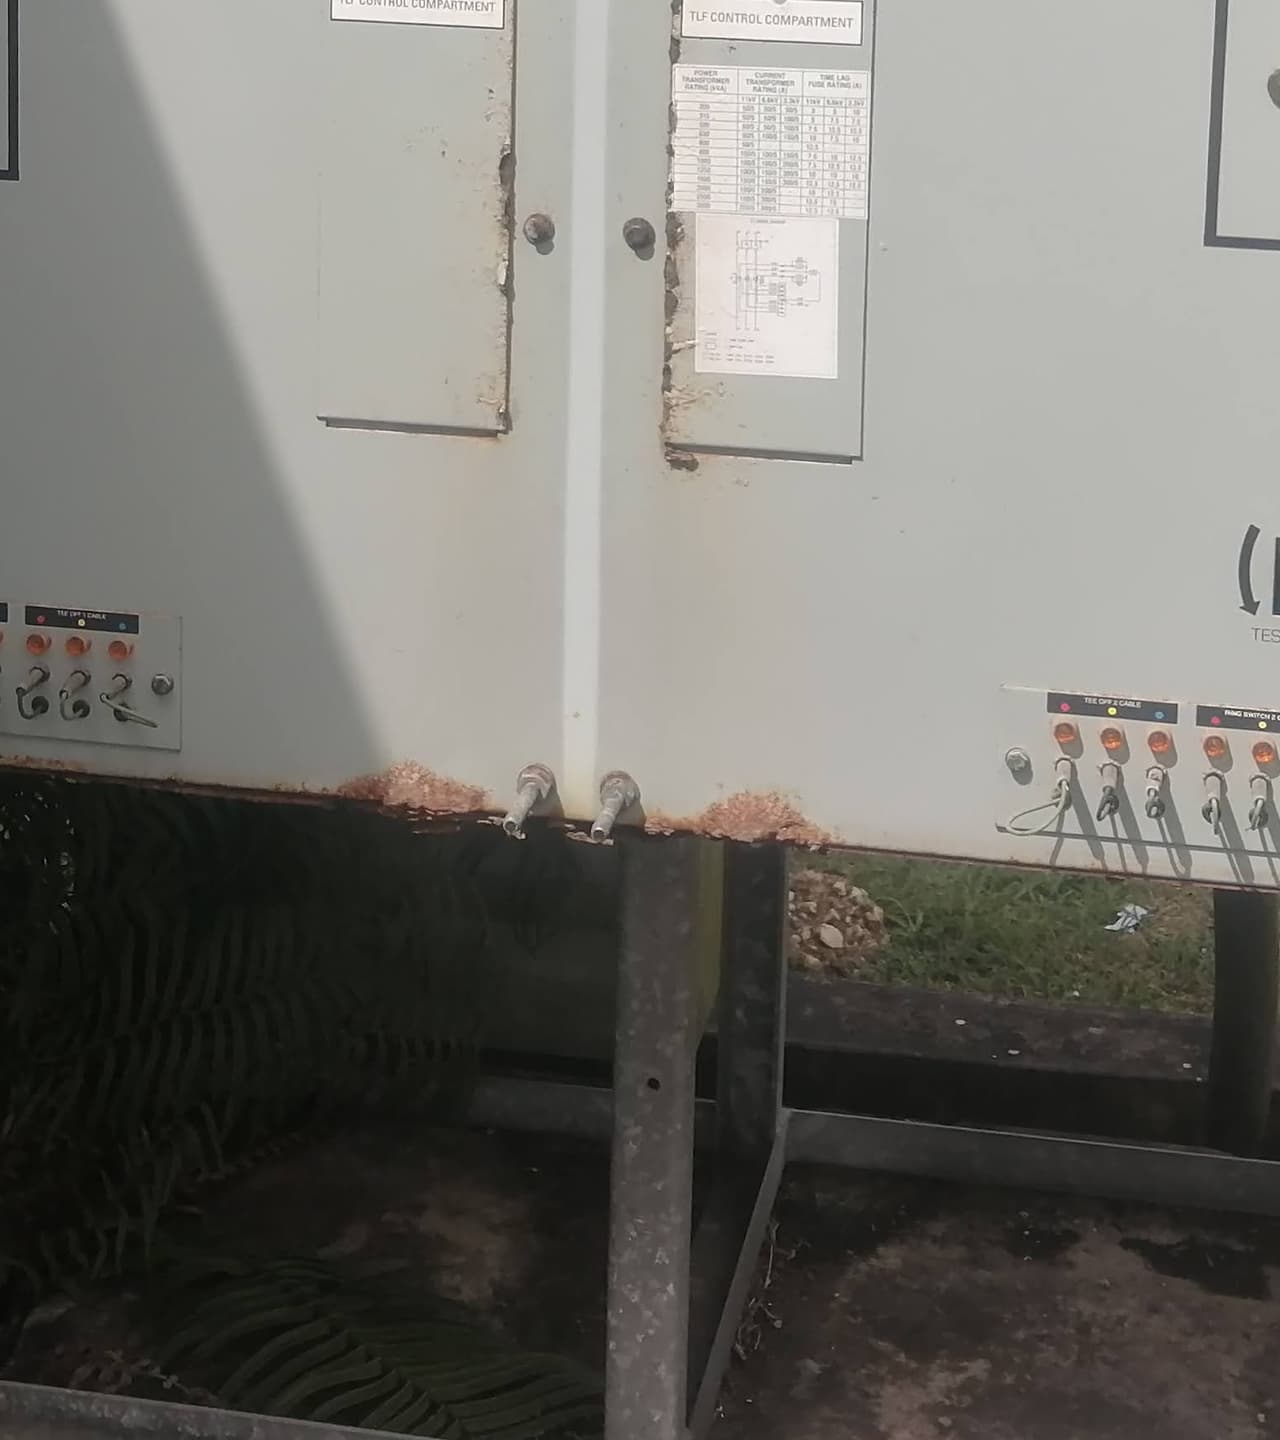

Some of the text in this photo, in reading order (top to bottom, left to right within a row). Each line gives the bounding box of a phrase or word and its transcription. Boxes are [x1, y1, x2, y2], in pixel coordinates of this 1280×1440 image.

[690, 11, 854, 29] TLF CONTROL COMPARTMENT
[1118, 699, 1141, 708] CABLE
[1224, 709, 1242, 718] RING
[1243, 710, 1271, 720] SWITCH
